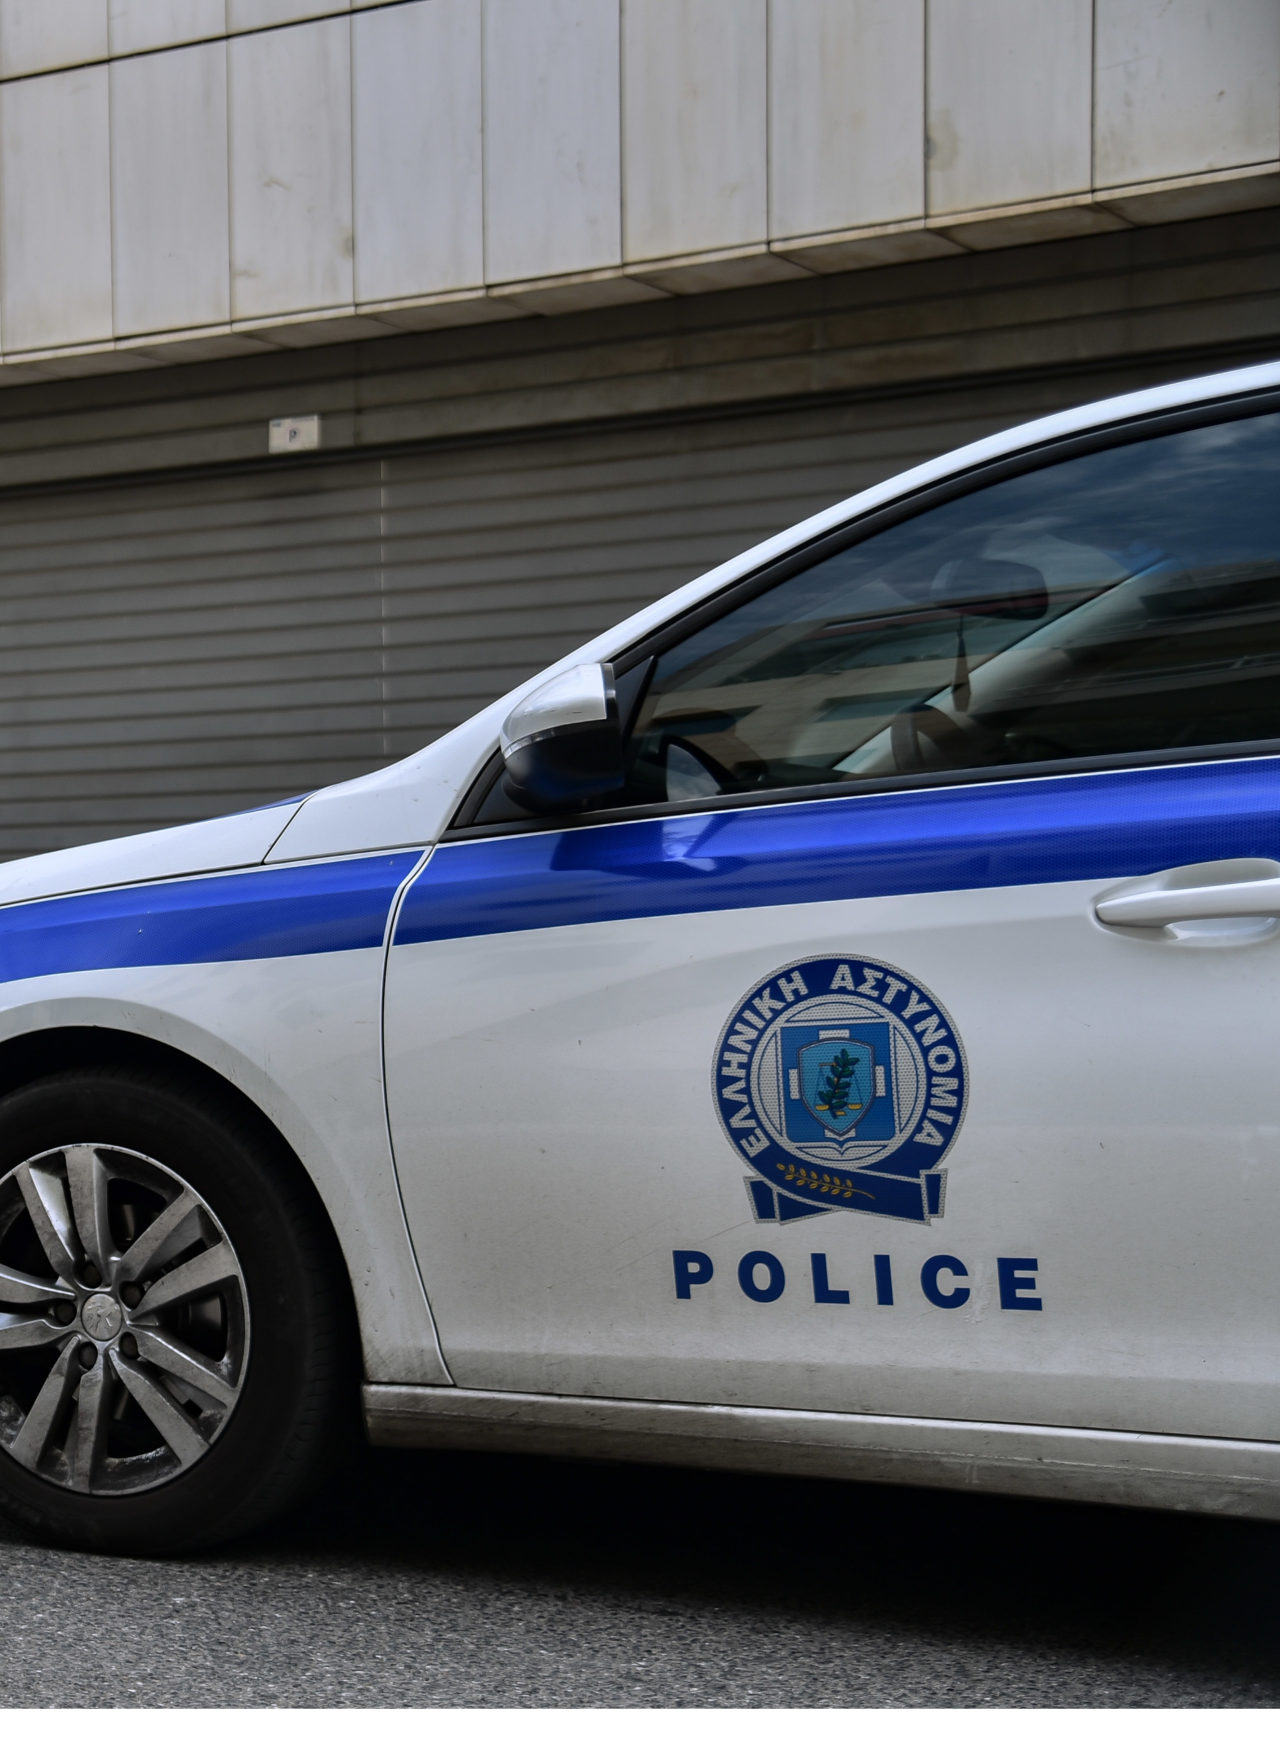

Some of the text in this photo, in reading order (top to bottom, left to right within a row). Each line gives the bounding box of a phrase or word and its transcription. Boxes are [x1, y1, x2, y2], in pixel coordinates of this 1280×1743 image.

[721, 963, 958, 1158] ΕΛΛΗΝΙΚΗ ΑΣΤΥΝΟΜΙΑ
[672, 1249, 1043, 1311] POLICE
